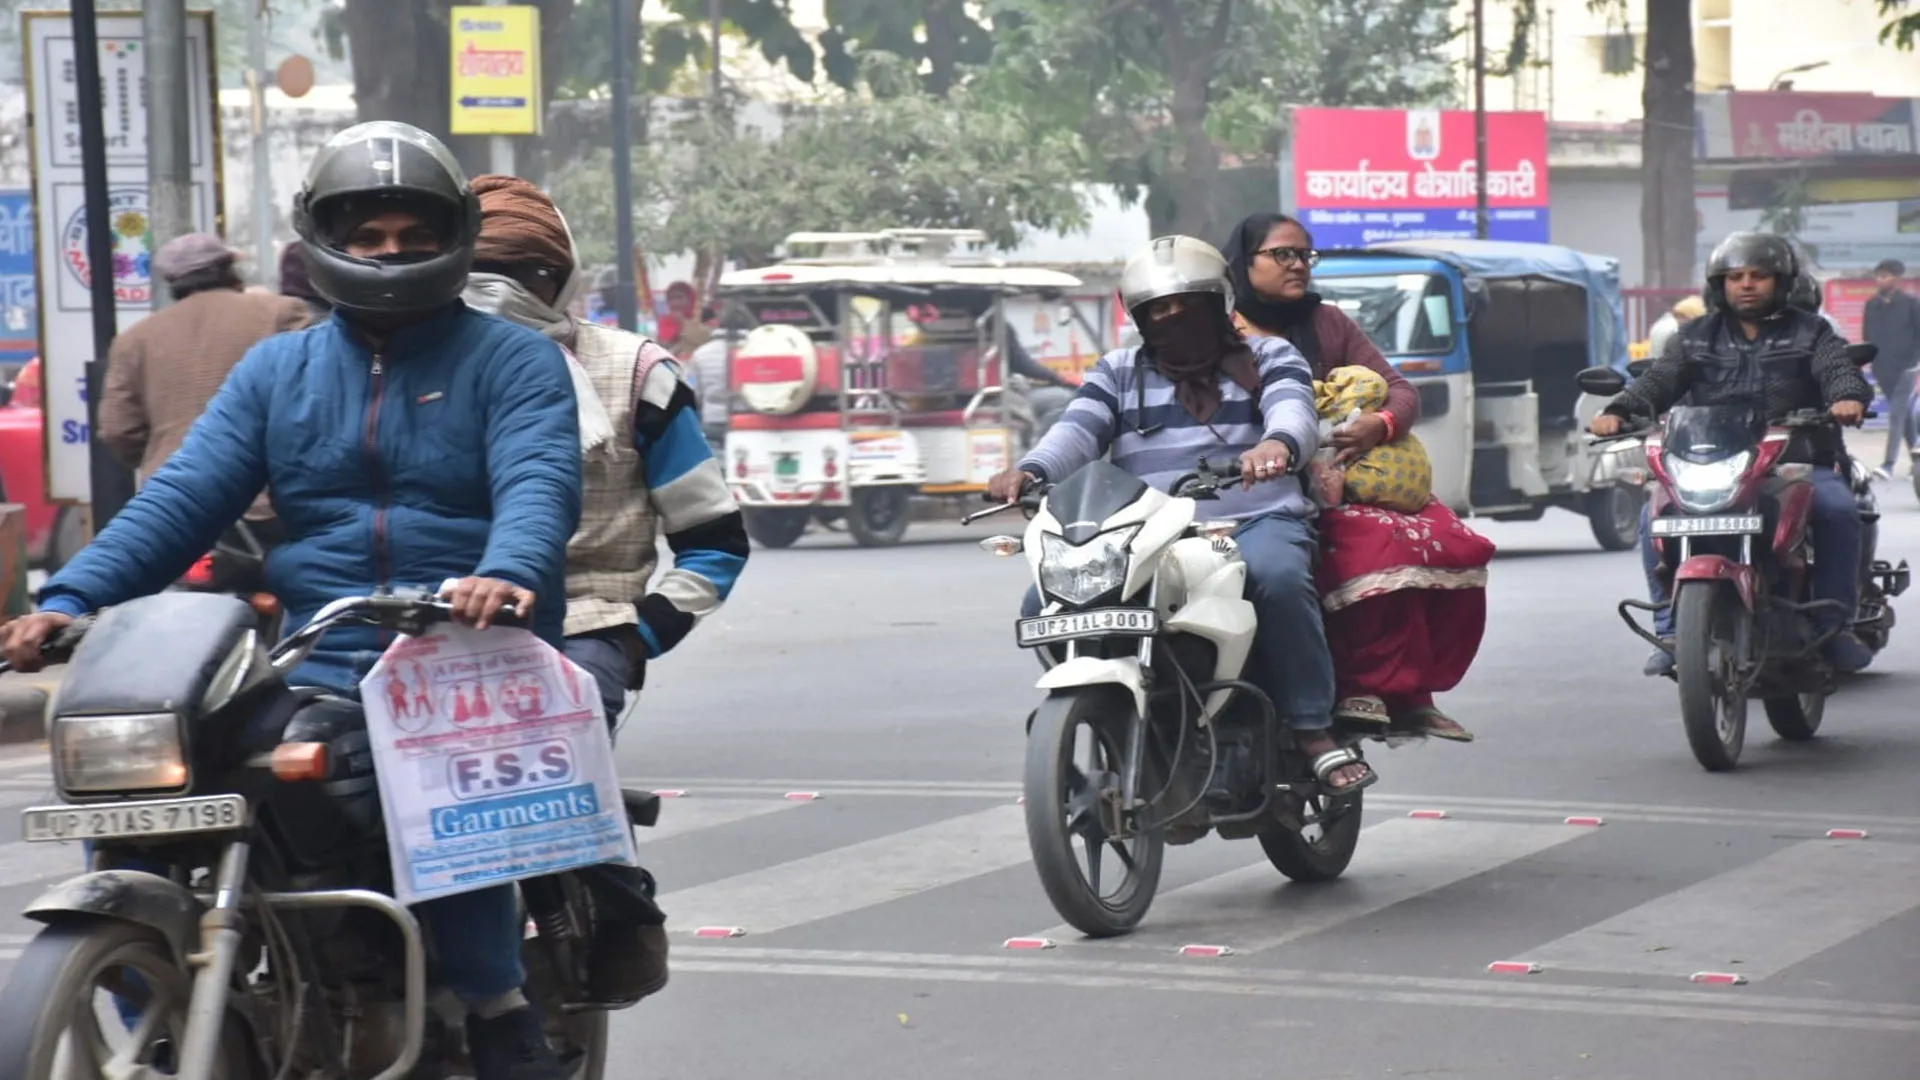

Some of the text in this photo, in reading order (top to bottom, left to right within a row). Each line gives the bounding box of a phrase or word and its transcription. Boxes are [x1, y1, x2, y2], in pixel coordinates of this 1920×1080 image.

[63, 132, 129, 147] Srt
[1775, 108, 1911, 153] महिला थाना
[1305, 159, 1409, 200] कार्यालय
[456, 745, 570, 793] F.S.S
[91, 809, 154, 835] 21AS
[163, 802, 236, 829] 7198
[435, 791, 595, 836] Garments
